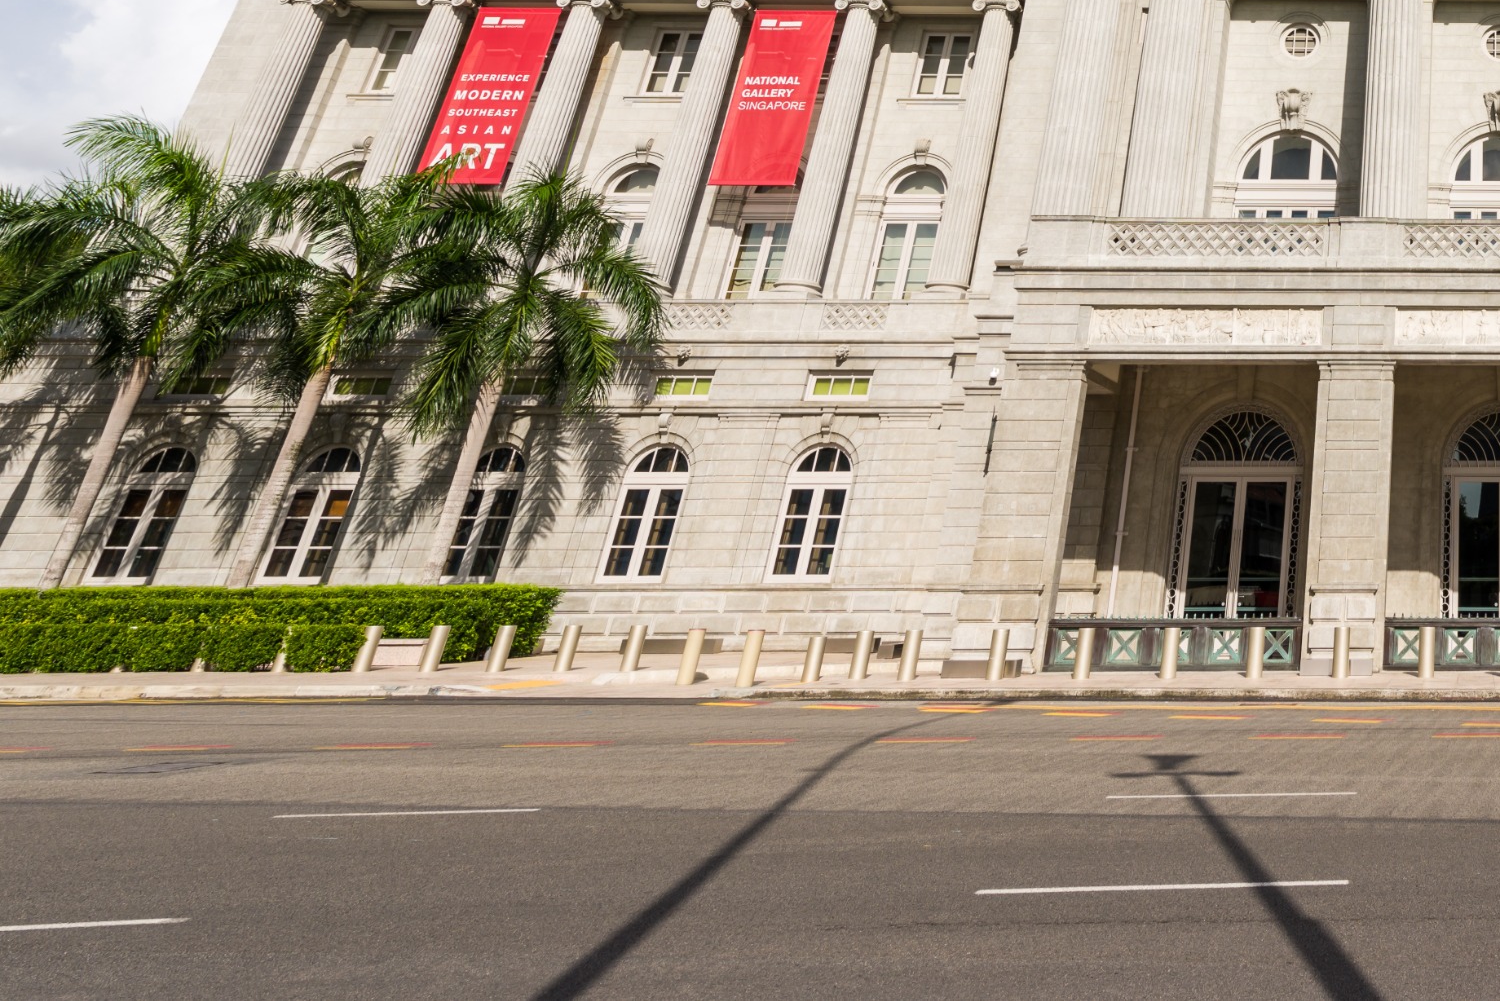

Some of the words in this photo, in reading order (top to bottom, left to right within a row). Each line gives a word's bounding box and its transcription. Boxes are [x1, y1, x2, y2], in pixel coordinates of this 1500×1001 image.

[461, 74, 529, 82] EXPERIENCE
[744, 76, 800, 85] NATIONAL
[454, 90, 525, 100] MODERN
[741, 89, 794, 97] GALLERY
[738, 101, 805, 110] SINGAPORE
[447, 108, 518, 116] SOUTHEAST
[428, 143, 504, 169] ART
